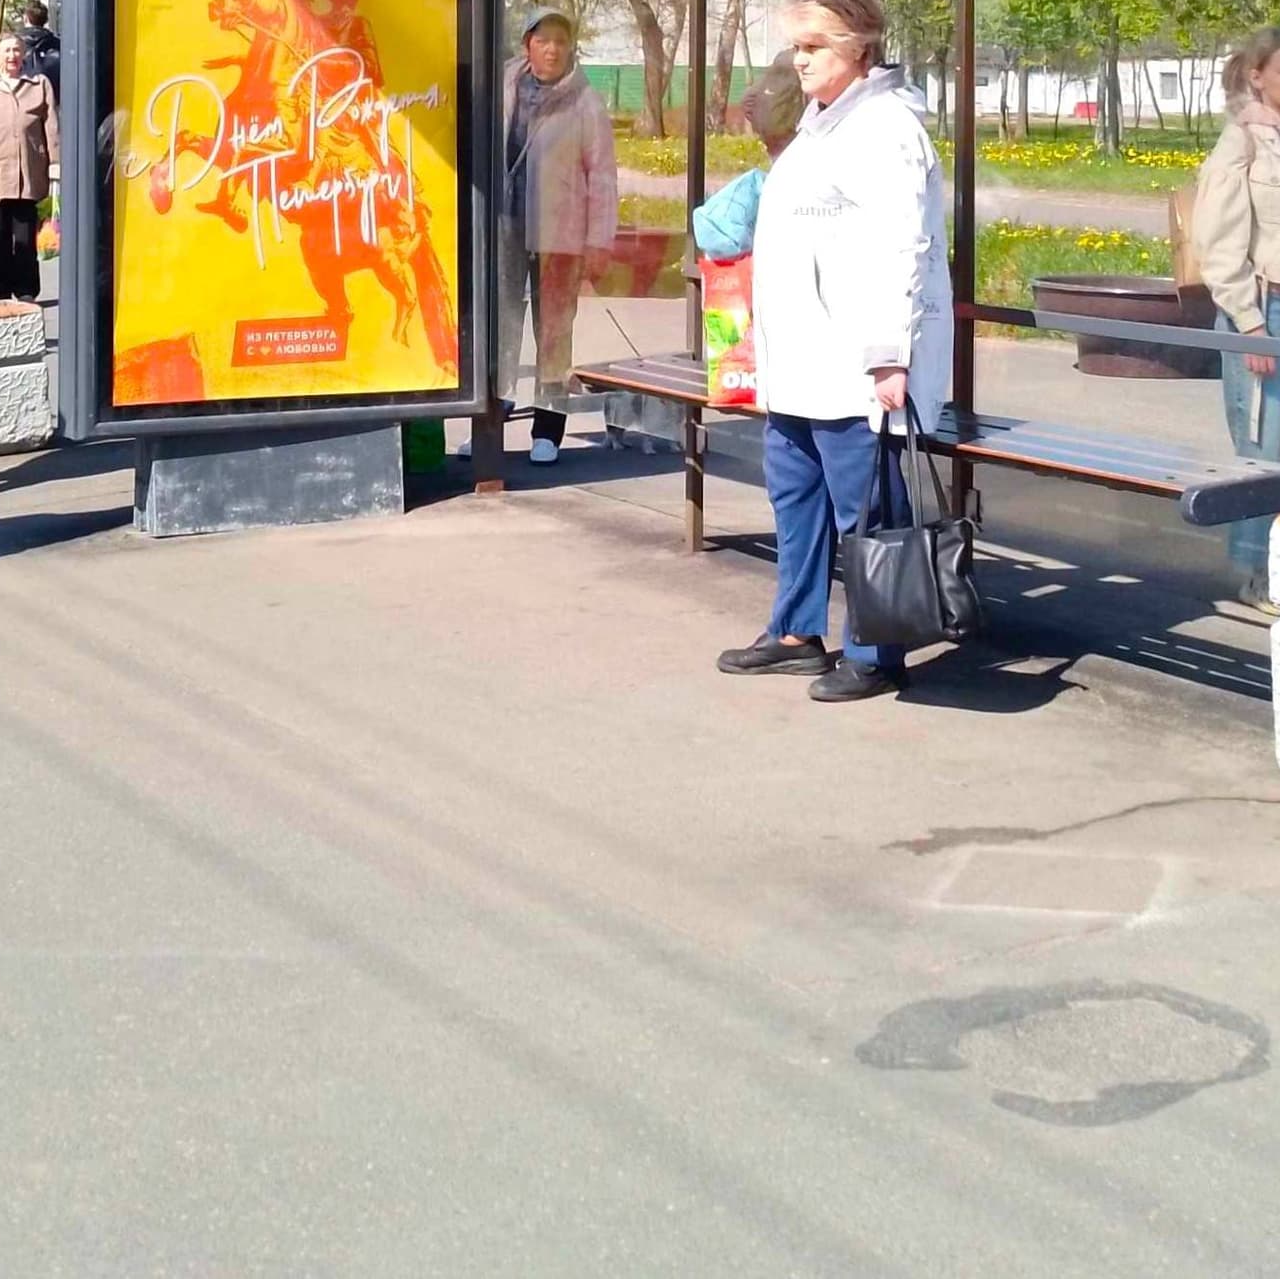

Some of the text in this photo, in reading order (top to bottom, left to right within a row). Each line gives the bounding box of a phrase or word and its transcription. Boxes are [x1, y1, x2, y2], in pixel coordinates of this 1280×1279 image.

[247, 329, 337, 342] ИЗ ПЕТЕРБУРГА
[247, 343, 337, 356] С ЛЮБОВЬЮ
